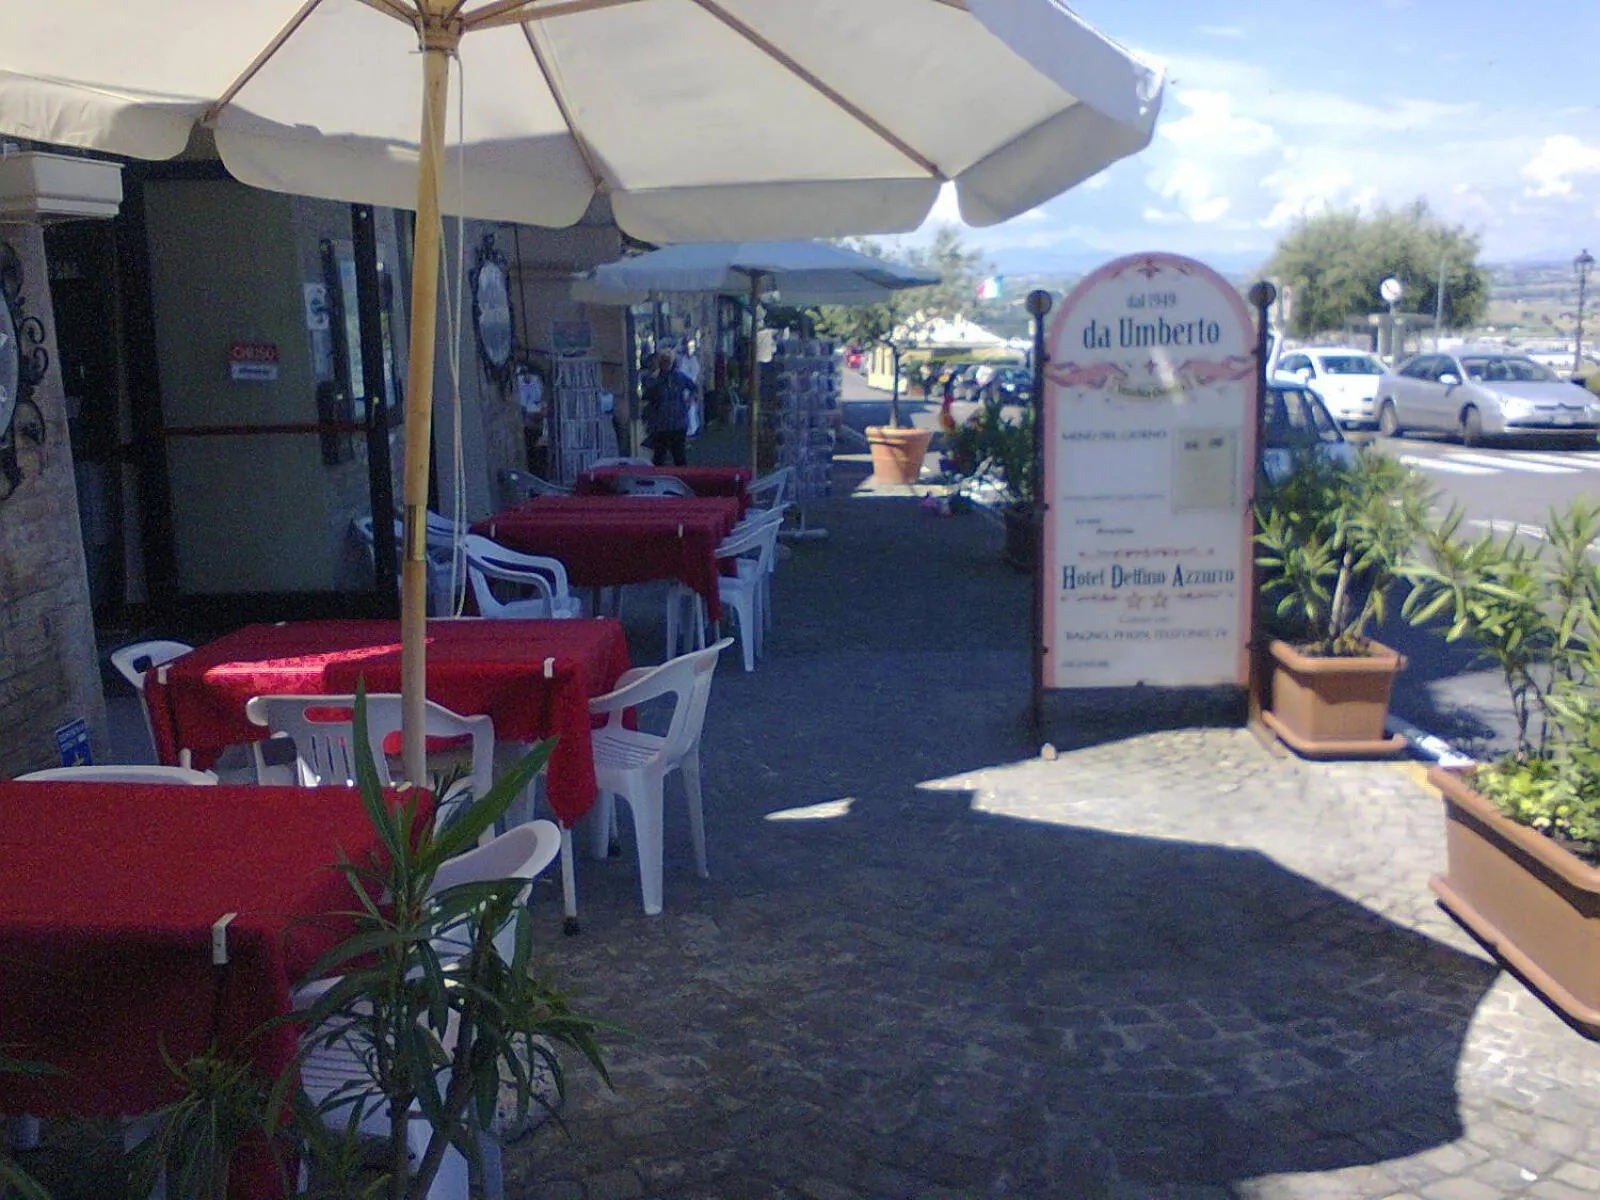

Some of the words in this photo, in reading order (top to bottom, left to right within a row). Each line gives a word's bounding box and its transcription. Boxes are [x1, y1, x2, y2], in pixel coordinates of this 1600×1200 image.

[1126, 292, 1145, 308] dal
[1083, 319, 1110, 349] da
[1119, 316, 1220, 348] Umberto
[1062, 564, 1105, 590] Hotel
[1111, 563, 1167, 589] Delfino
[1172, 563, 1236, 588] Azzurro
